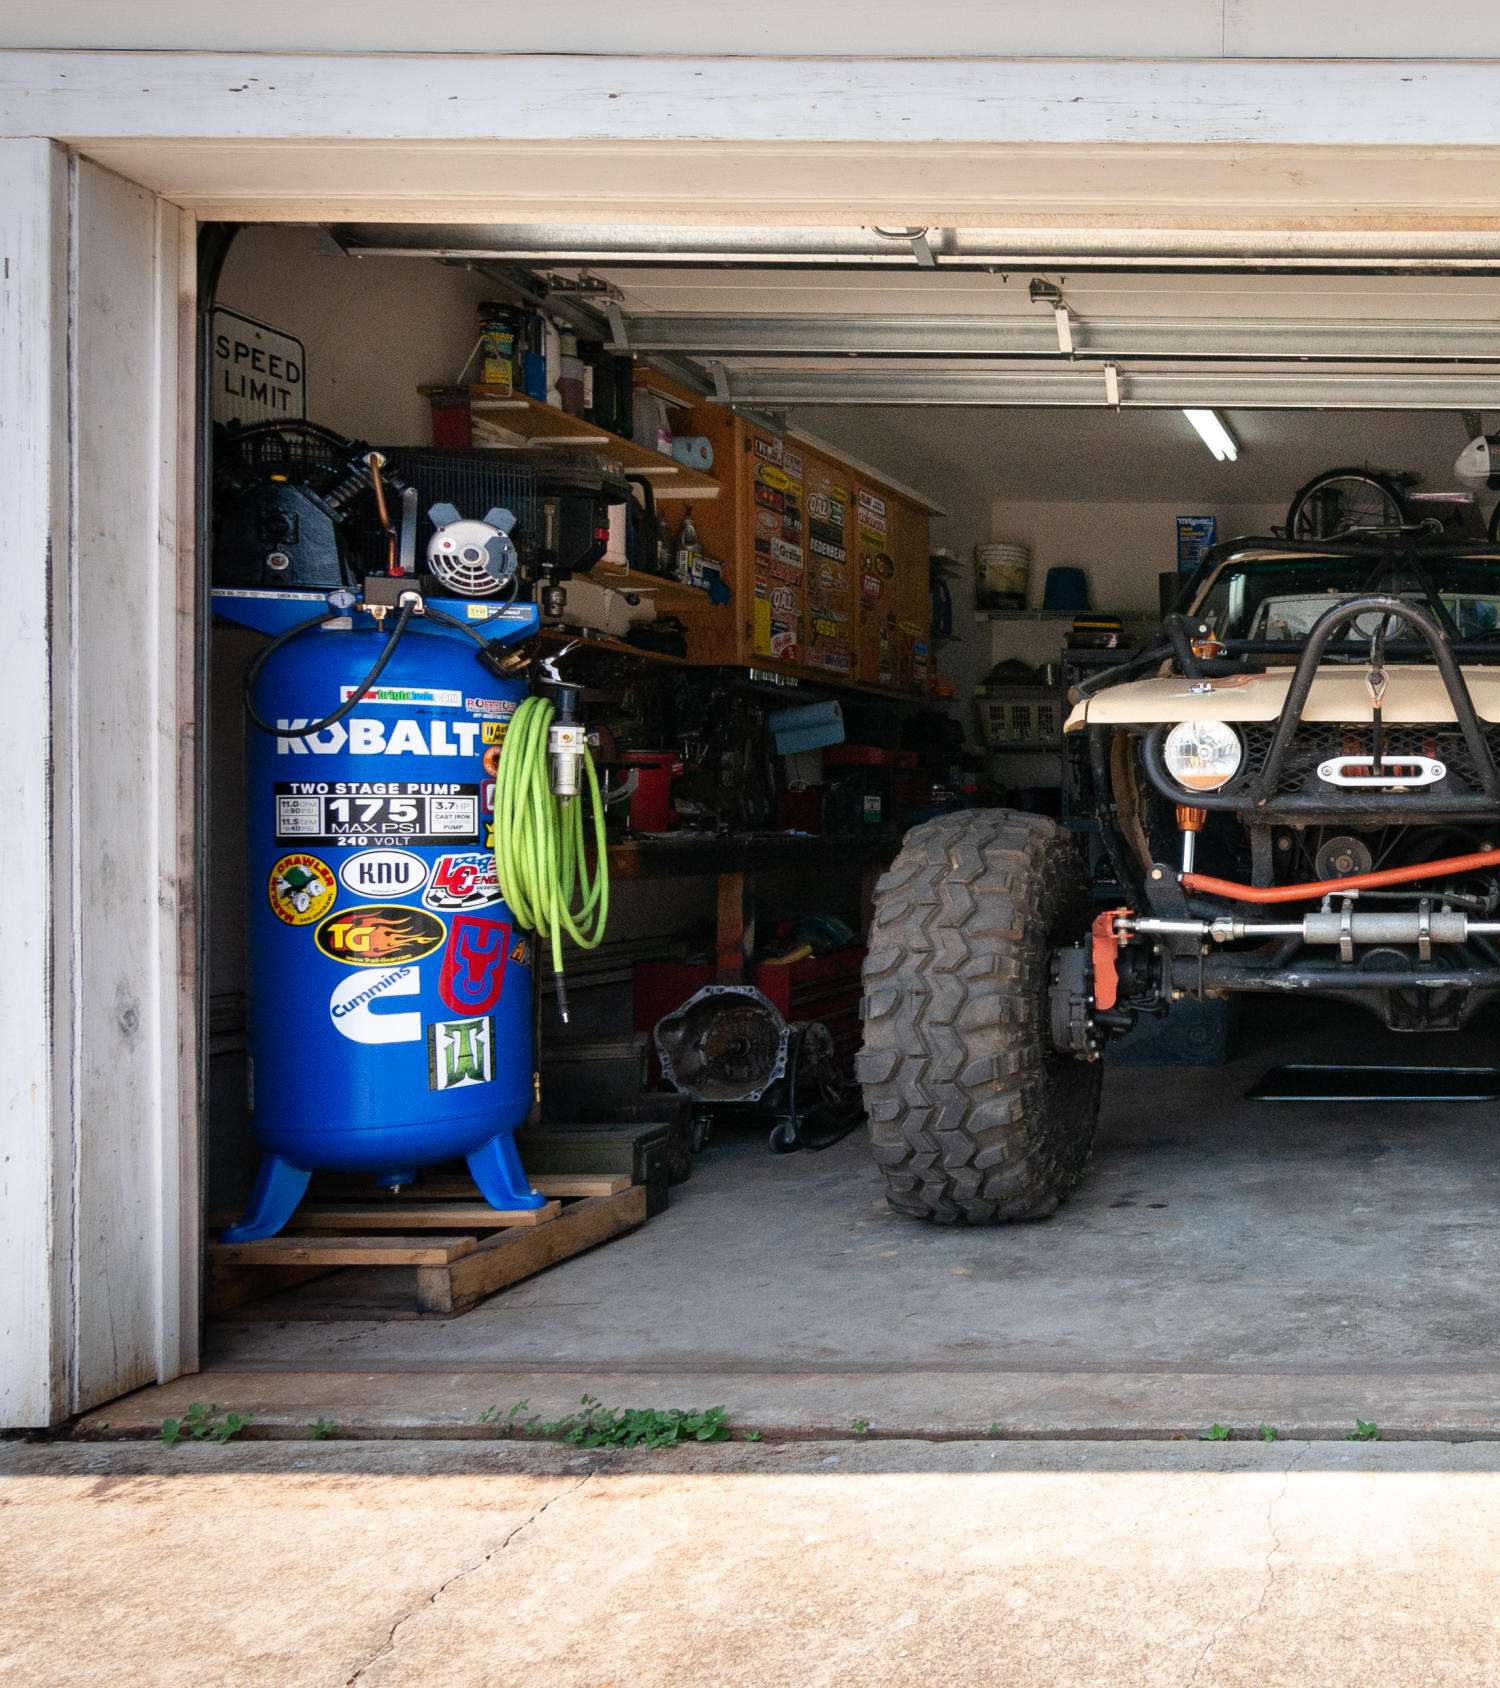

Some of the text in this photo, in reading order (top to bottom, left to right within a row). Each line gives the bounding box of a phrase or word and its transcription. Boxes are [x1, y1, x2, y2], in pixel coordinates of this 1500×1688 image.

[216, 335, 300, 384] SPEED
[225, 369, 291, 412] LIMIT
[277, 718, 480, 757] KOBALT
[290, 783, 461, 795] TWO STAGE PUMP
[329, 798, 418, 823] 175
[435, 802, 456, 810] 3.7
[281, 818, 300, 826] 11.5
[332, 823, 420, 833] MAX PSI
[337, 837, 411, 846] 240 VOLT
[277, 856, 334, 887] CRAWLER
[435, 858, 478, 895] LC
[327, 923, 377, 952] TG
[331, 967, 411, 1018] Cummins
